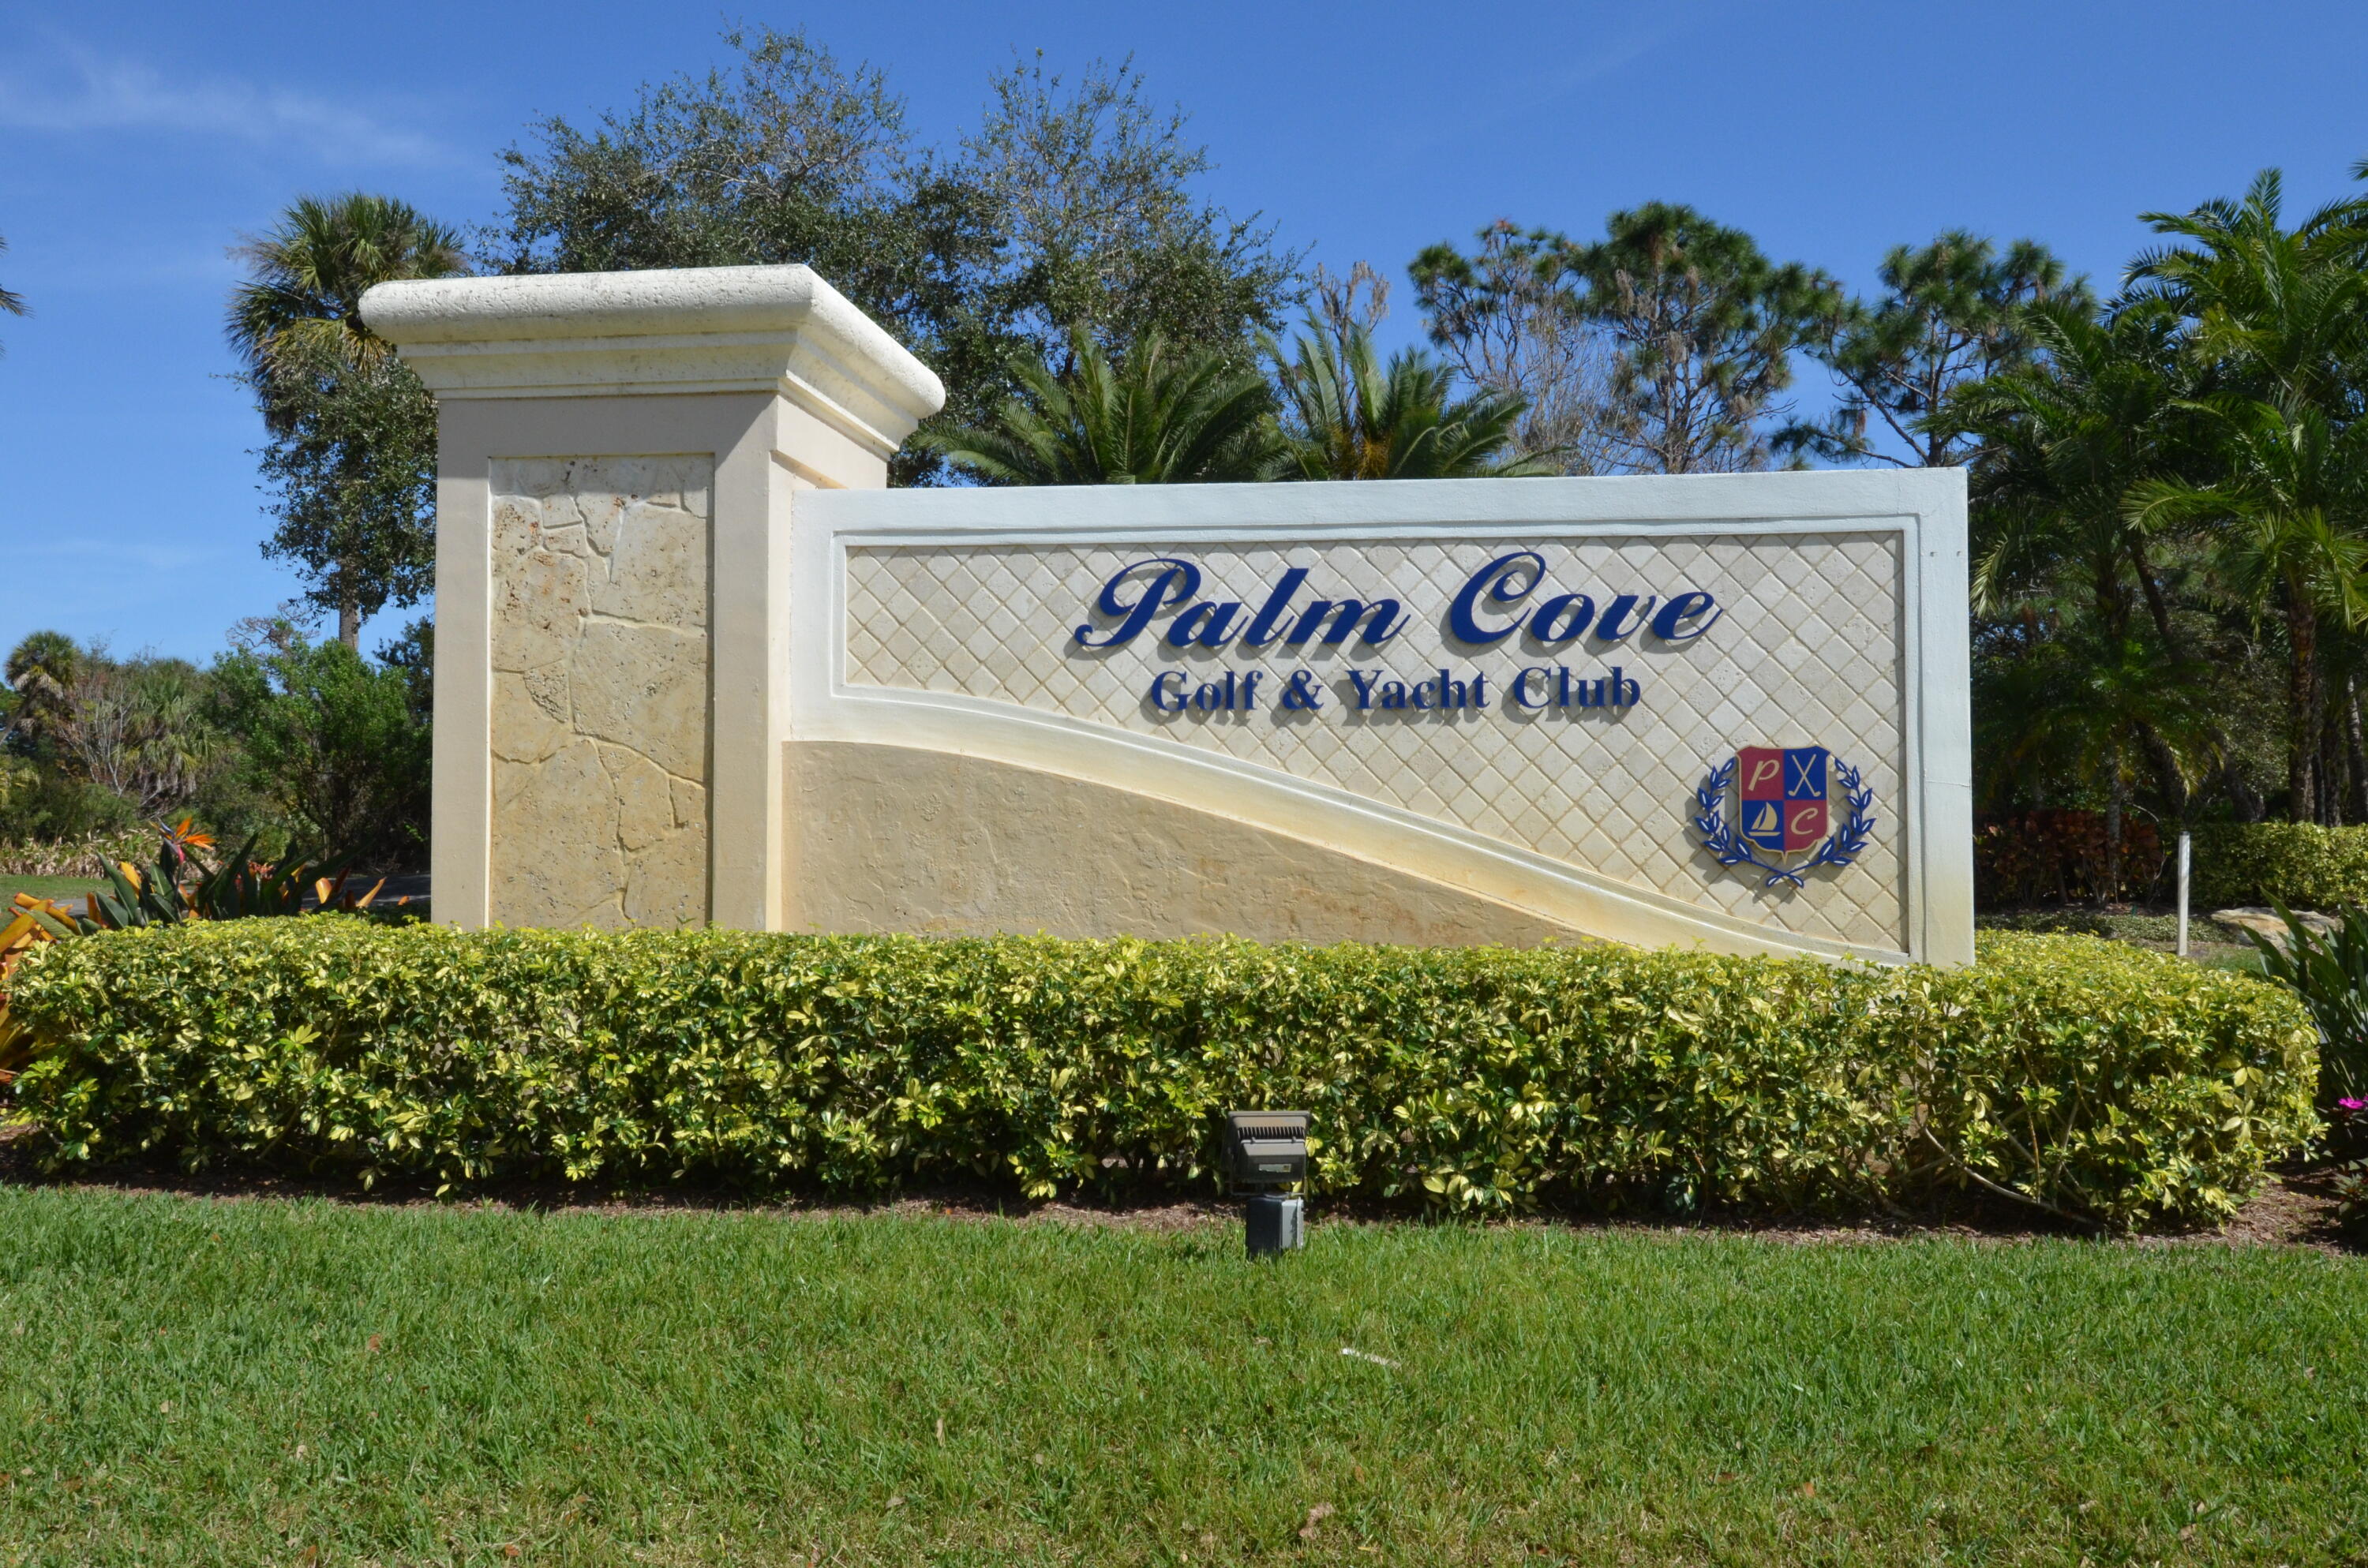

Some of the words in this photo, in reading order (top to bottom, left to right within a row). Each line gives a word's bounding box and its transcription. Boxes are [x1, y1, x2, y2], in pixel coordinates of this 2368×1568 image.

[1073, 557, 1411, 647] Palm
[1450, 552, 1724, 646] Cove
[1150, 669, 1264, 712] Golf
[1282, 668, 1324, 710] &
[1346, 668, 1489, 709] Yacht
[1513, 666, 1641, 709] Club
[1748, 759, 1780, 791] P
[1790, 807, 1819, 835] C
